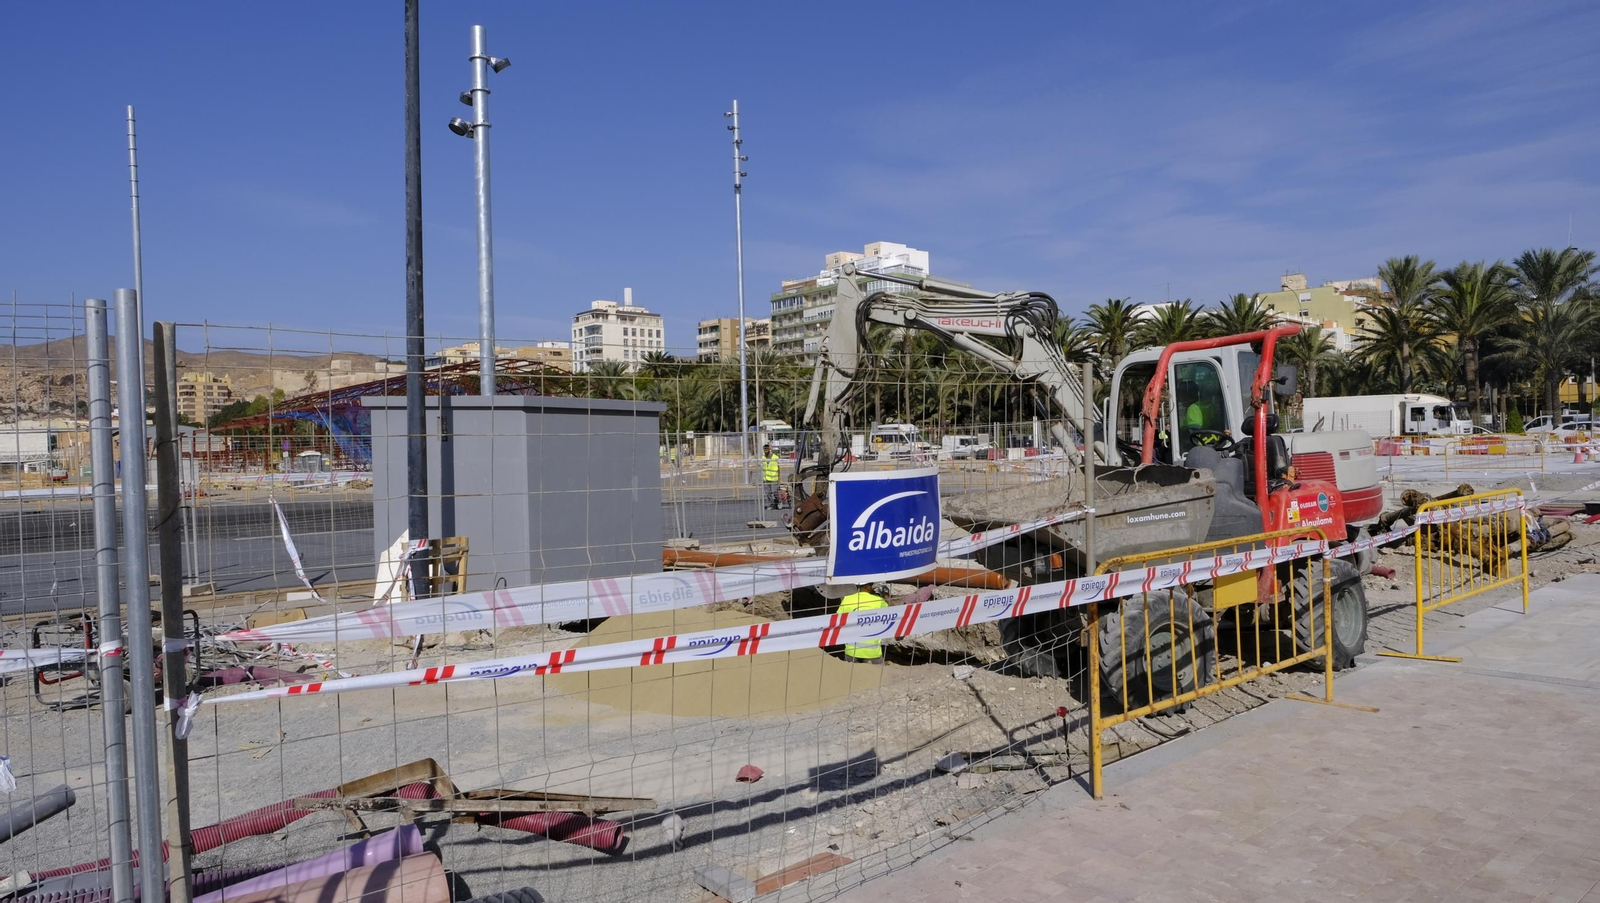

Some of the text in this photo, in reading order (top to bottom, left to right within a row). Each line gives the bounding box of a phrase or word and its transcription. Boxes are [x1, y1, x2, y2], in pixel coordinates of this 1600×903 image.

[1126, 510, 1187, 524] loxamhune.com
[848, 515, 935, 552] albaida
[983, 595, 1014, 609] albaida
[919, 606, 961, 619] grupoalbaida.com
[856, 613, 898, 628] albaida
